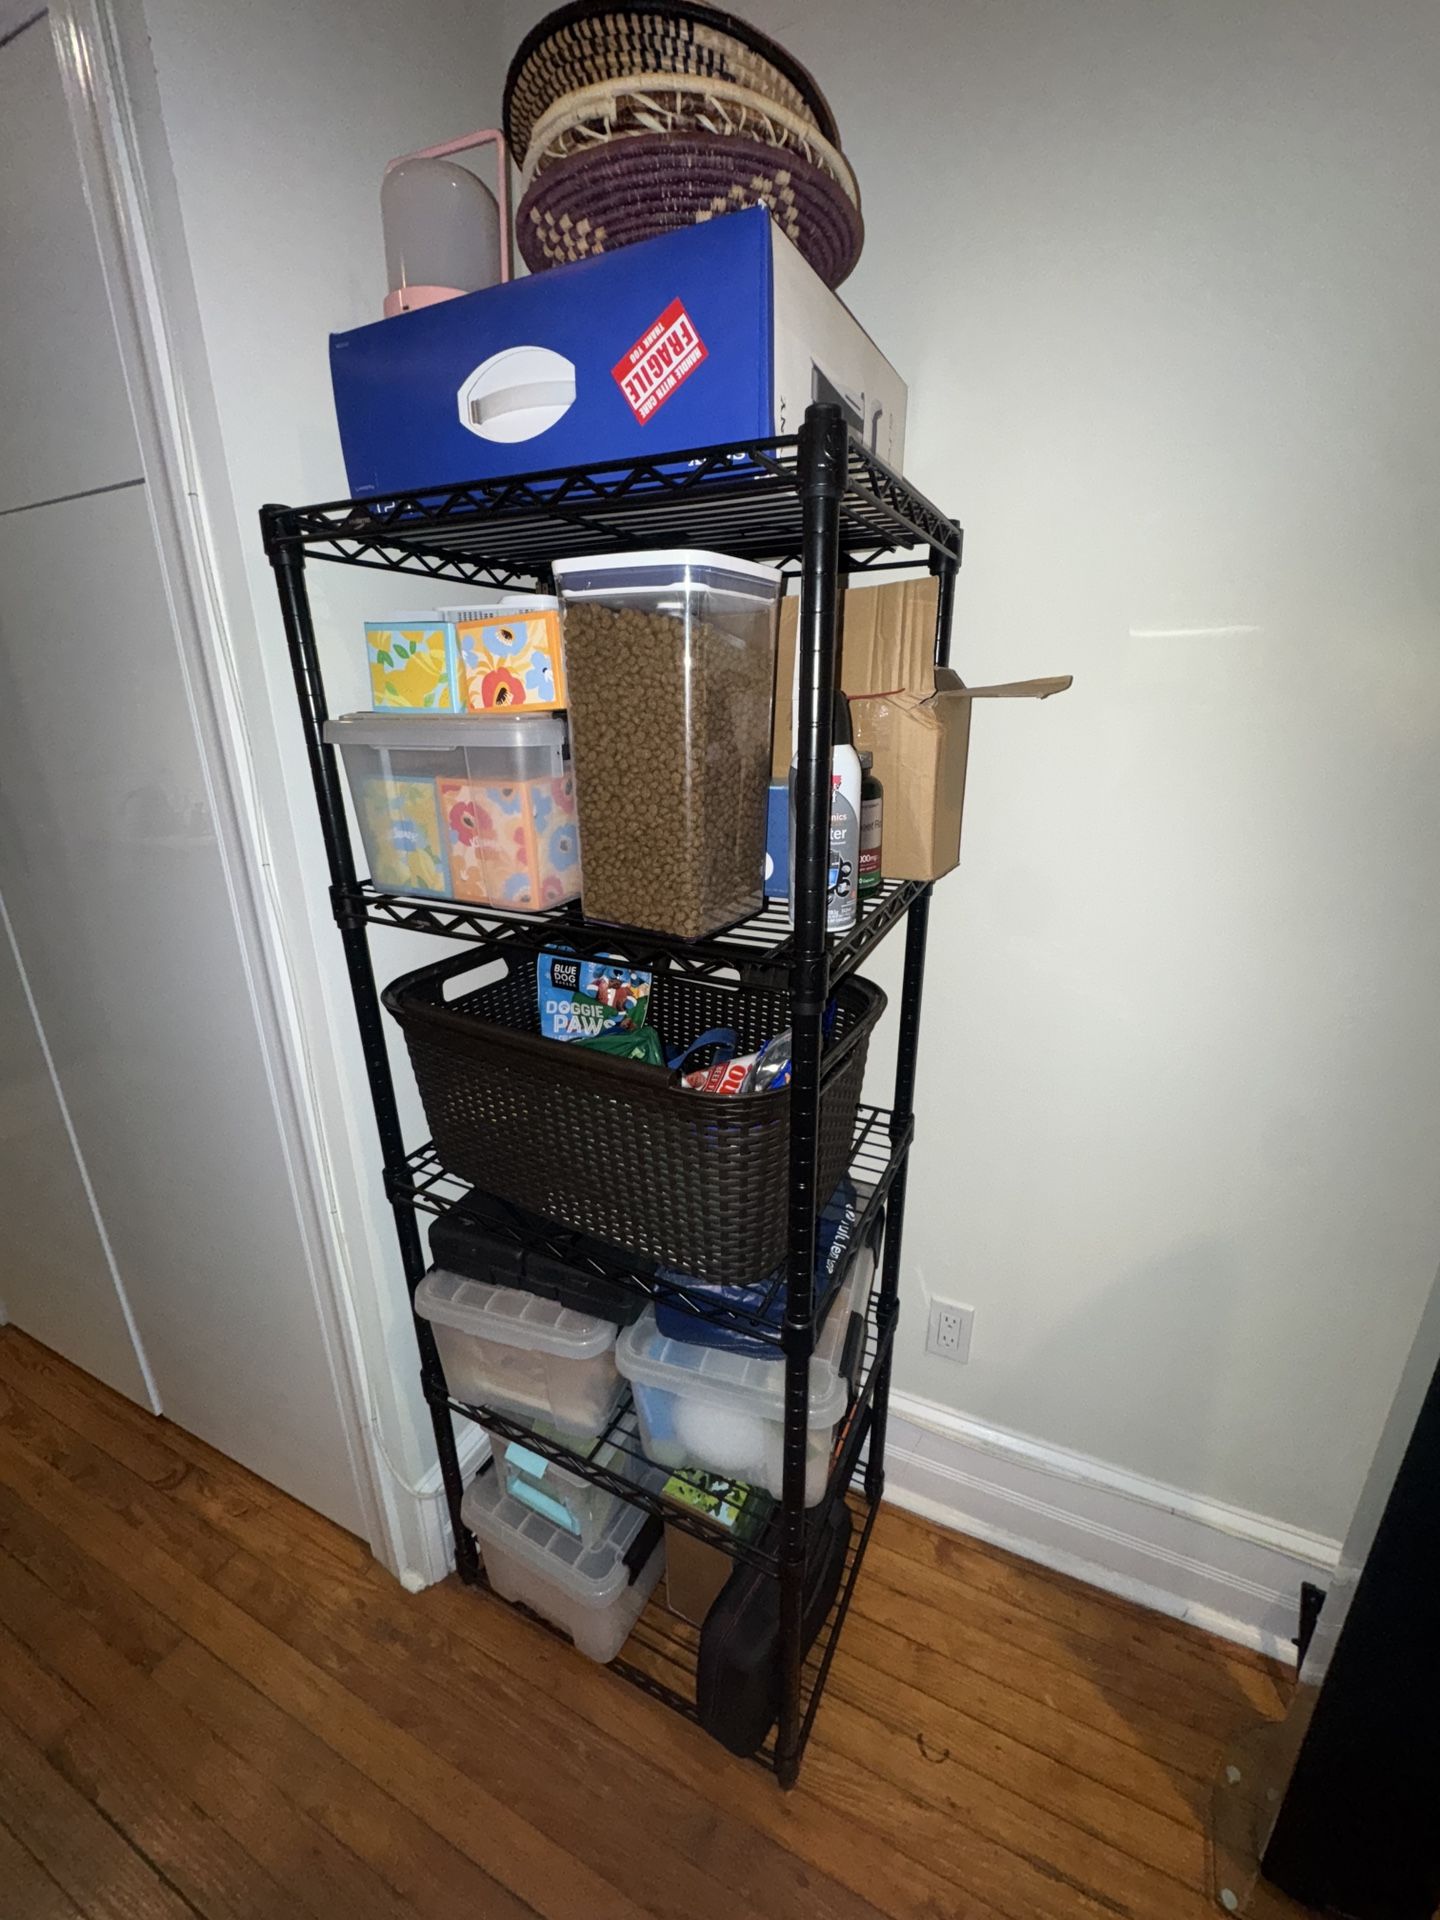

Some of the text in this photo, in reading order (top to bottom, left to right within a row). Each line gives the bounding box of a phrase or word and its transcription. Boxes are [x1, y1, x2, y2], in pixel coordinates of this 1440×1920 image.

[629, 322, 665, 365] THANK YOU
[625, 321, 694, 404] FRAGILE
[638, 346, 703, 419] HANDLE WITH CARE
[554, 963, 577, 976] BLUE
[554, 972, 577, 984] DOG
[545, 1000, 604, 1018] DOGGIE
